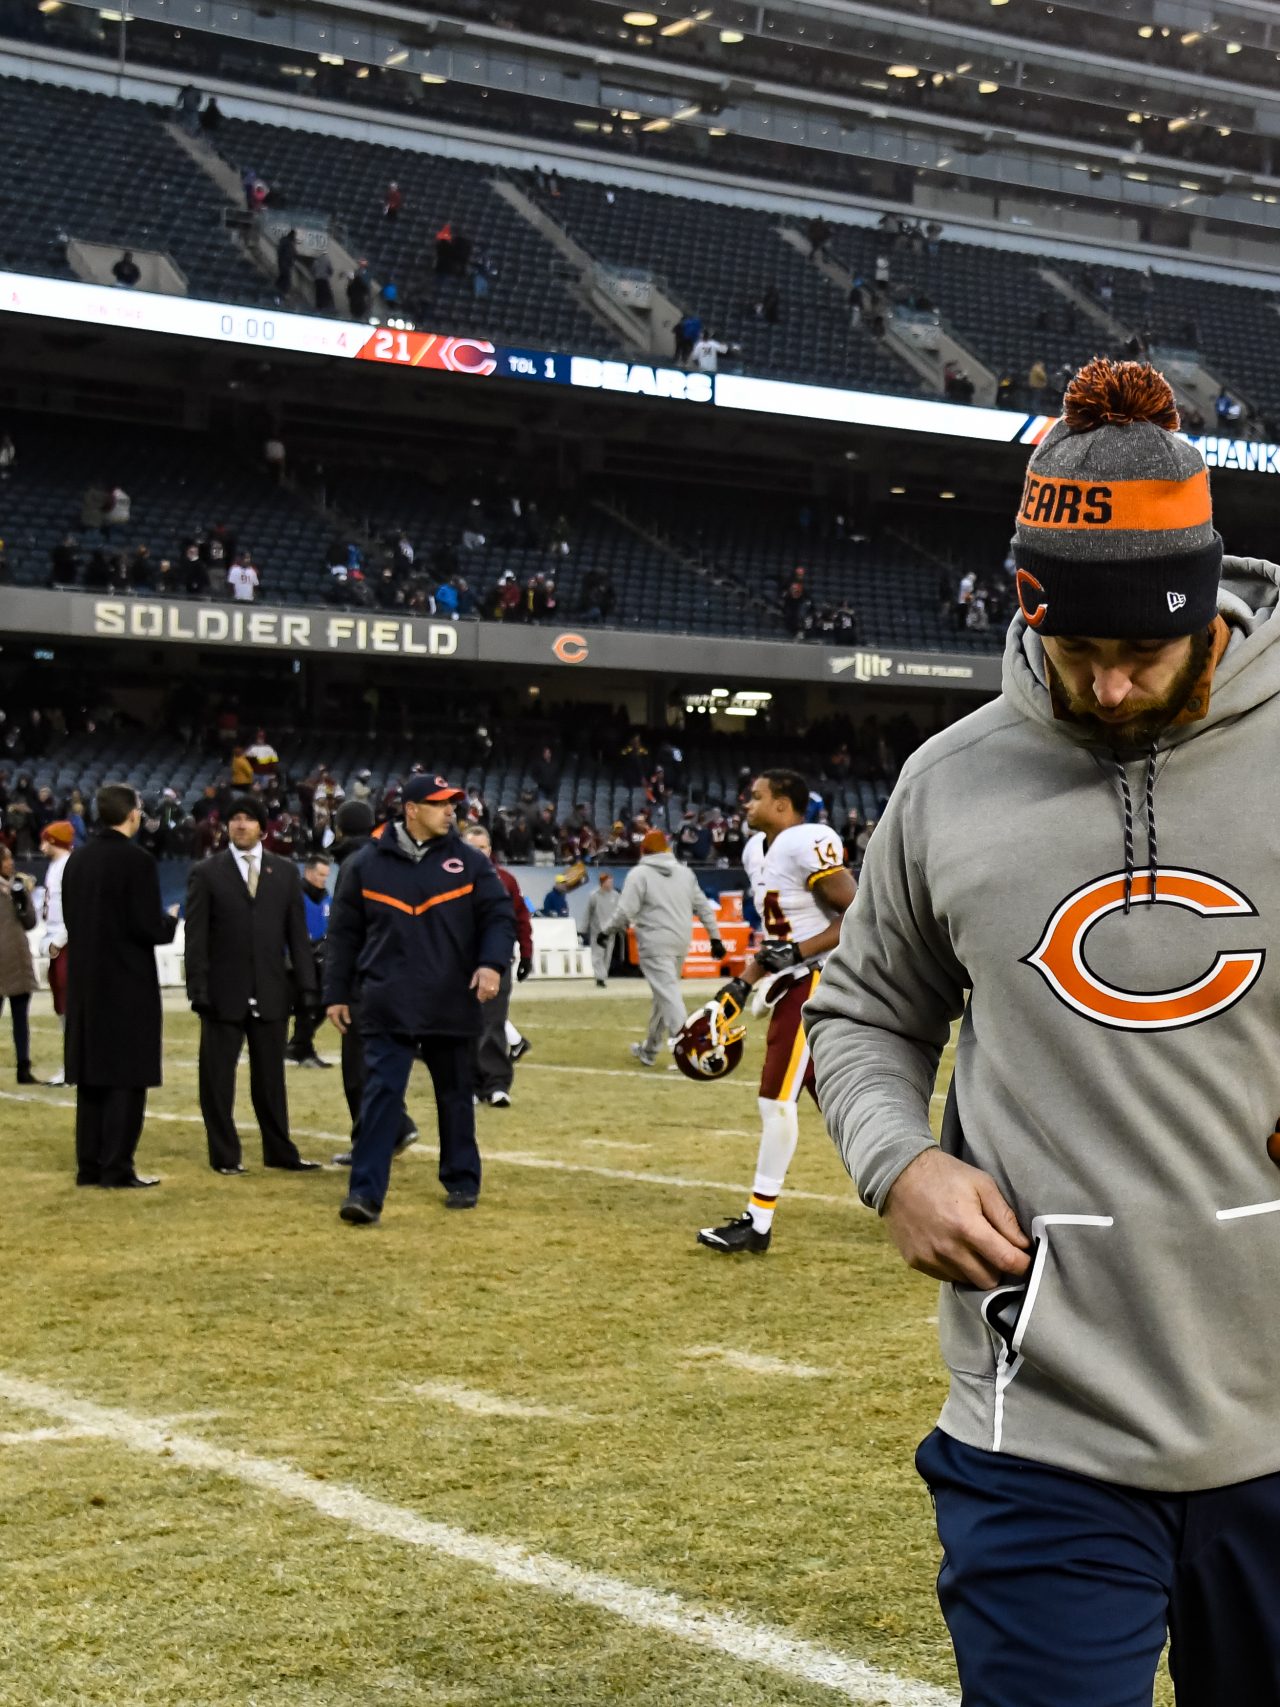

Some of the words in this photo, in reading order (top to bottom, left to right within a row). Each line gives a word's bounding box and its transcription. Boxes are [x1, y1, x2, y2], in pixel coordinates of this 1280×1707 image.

[374, 333, 412, 362] 21
[508, 355, 537, 375] TOL
[544, 358, 556, 379] 1
[570, 356, 713, 402] BEARS
[1020, 475, 1113, 525] EARS
[95, 602, 311, 647] SOLDIER
[327, 617, 458, 656] FIELD
[814, 842, 838, 866] 14
